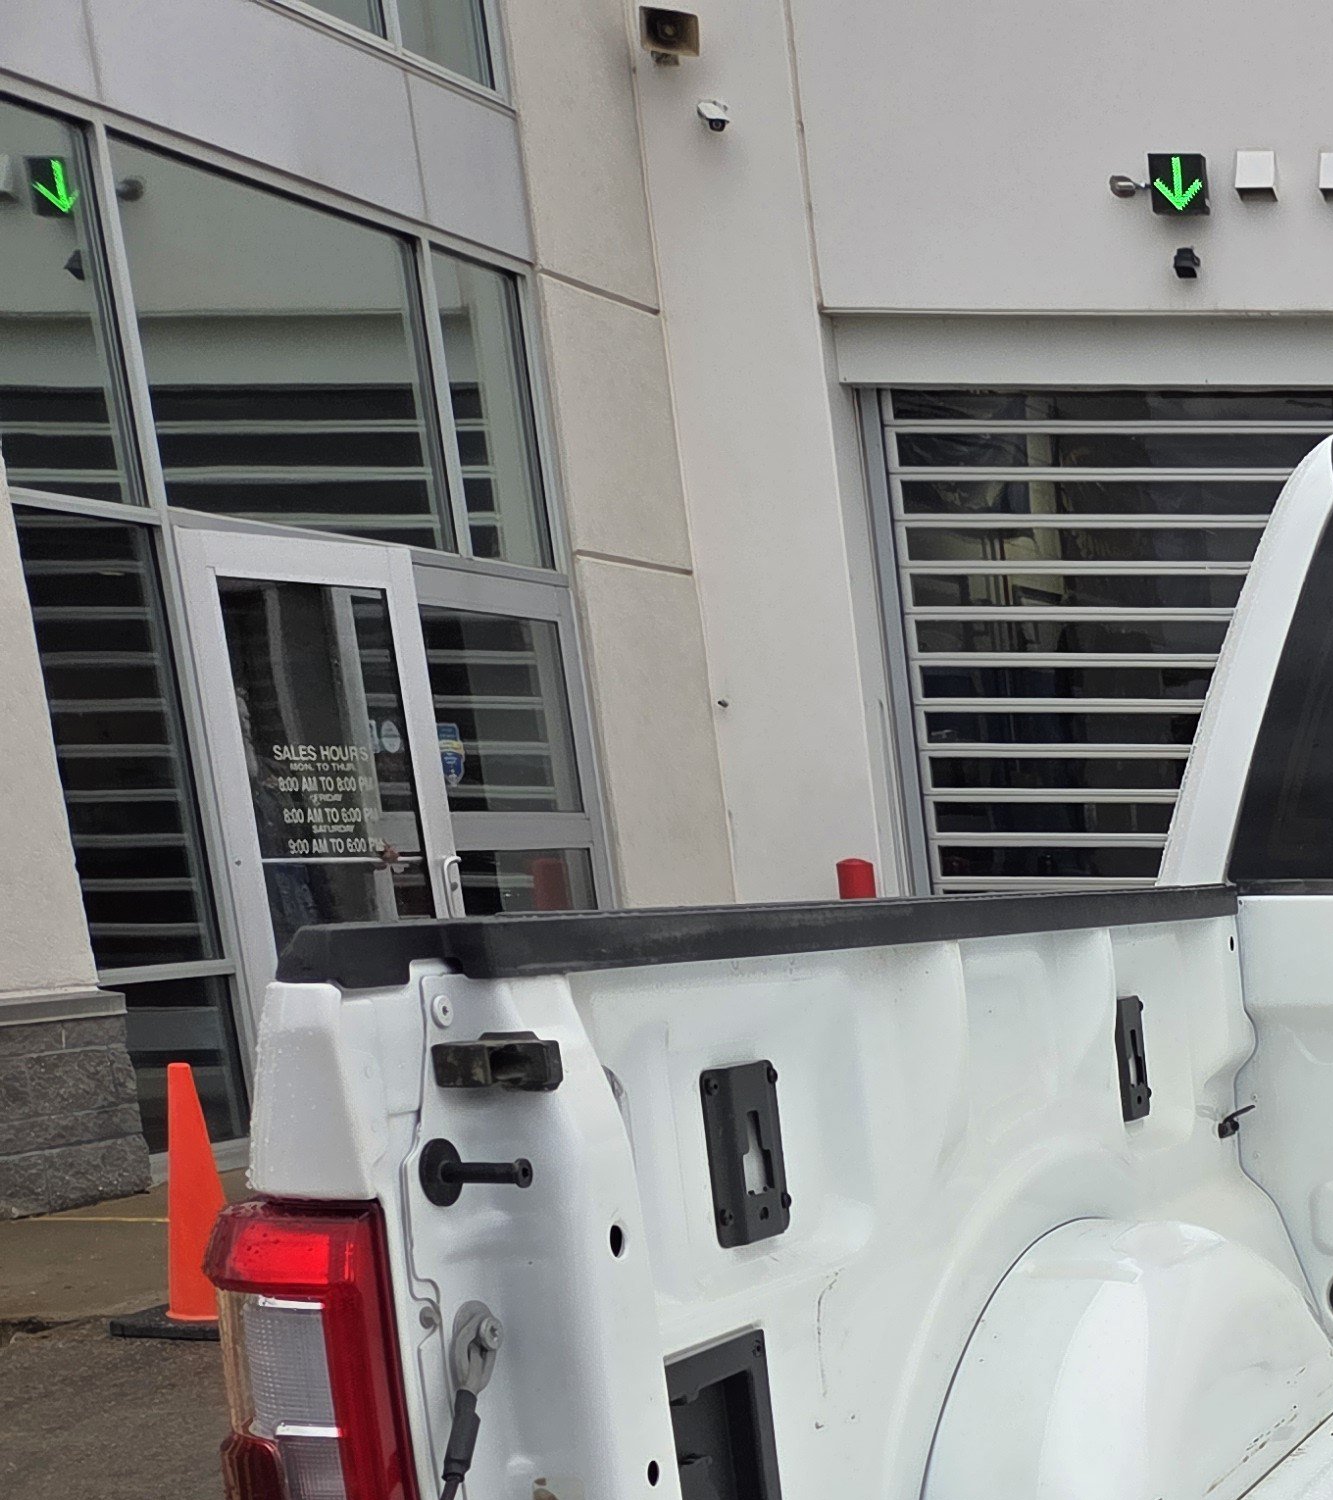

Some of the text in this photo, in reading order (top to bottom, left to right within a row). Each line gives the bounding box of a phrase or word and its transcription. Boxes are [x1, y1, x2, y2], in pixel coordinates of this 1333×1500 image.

[273, 744, 369, 762] SALES HOURS
[316, 763, 329, 771] TO
[302, 776, 318, 792] AM
[319, 776, 334, 791] TO
[358, 777, 375, 792] PM
[307, 808, 324, 823] AM
[324, 808, 339, 823] TO
[312, 838, 329, 853] AM
[329, 838, 344, 853] TO
[368, 837, 385, 852] PM
